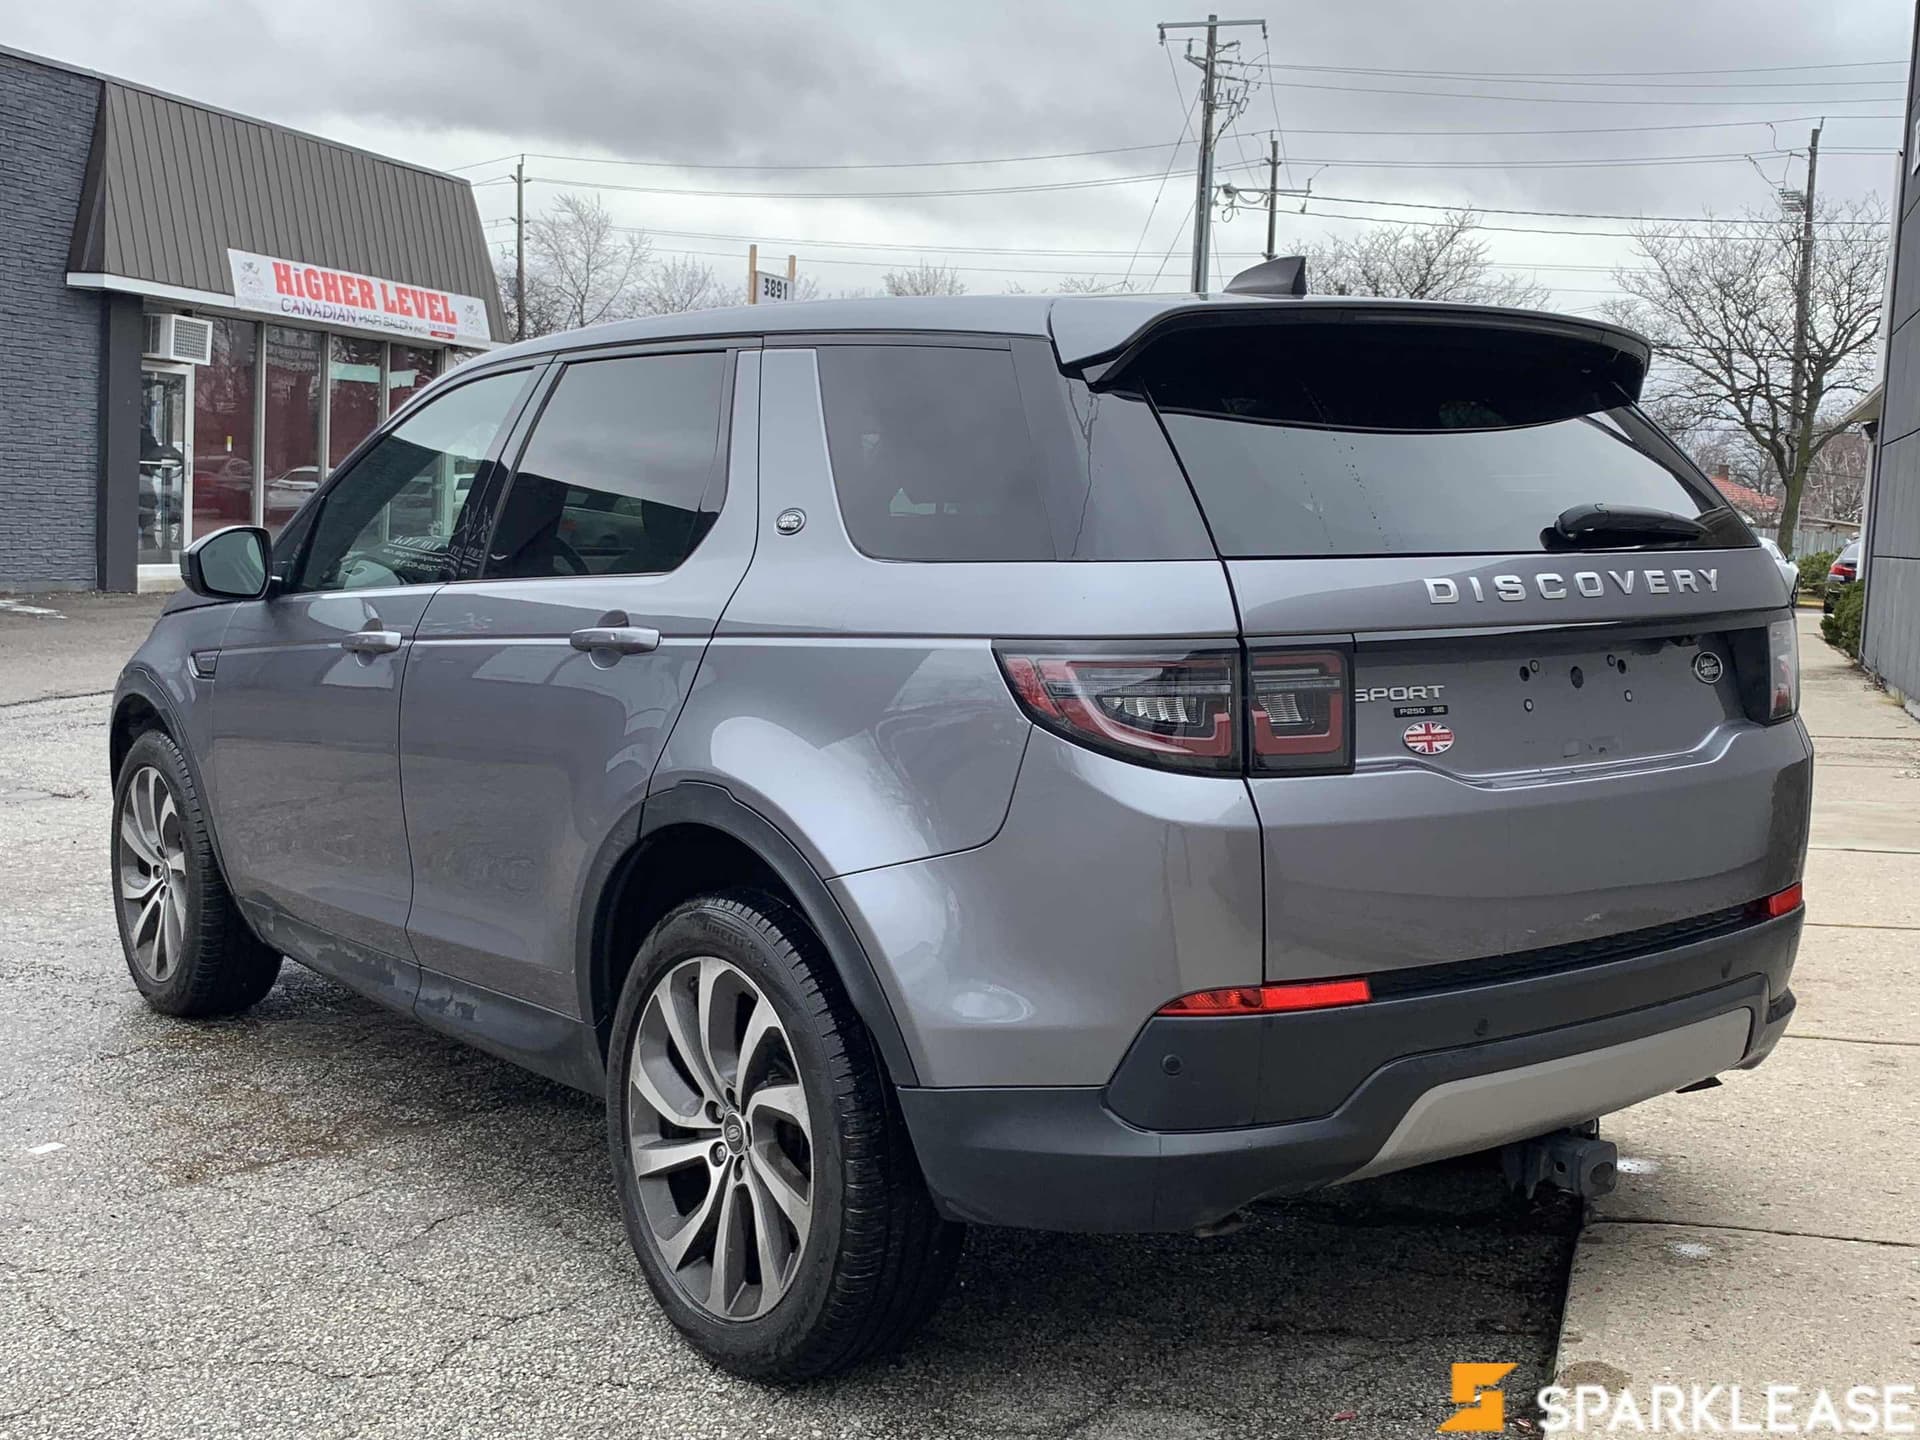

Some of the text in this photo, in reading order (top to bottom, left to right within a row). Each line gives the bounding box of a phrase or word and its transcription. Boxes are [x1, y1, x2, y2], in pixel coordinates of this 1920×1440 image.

[763, 277, 788, 301] 3891
[280, 297, 357, 323] CANADIAN
[380, 281, 457, 325] LEVEL
[1423, 568, 1718, 604] DISCOVERY
[1354, 684, 1445, 702] SPORT
[1399, 706, 1426, 716] P250
